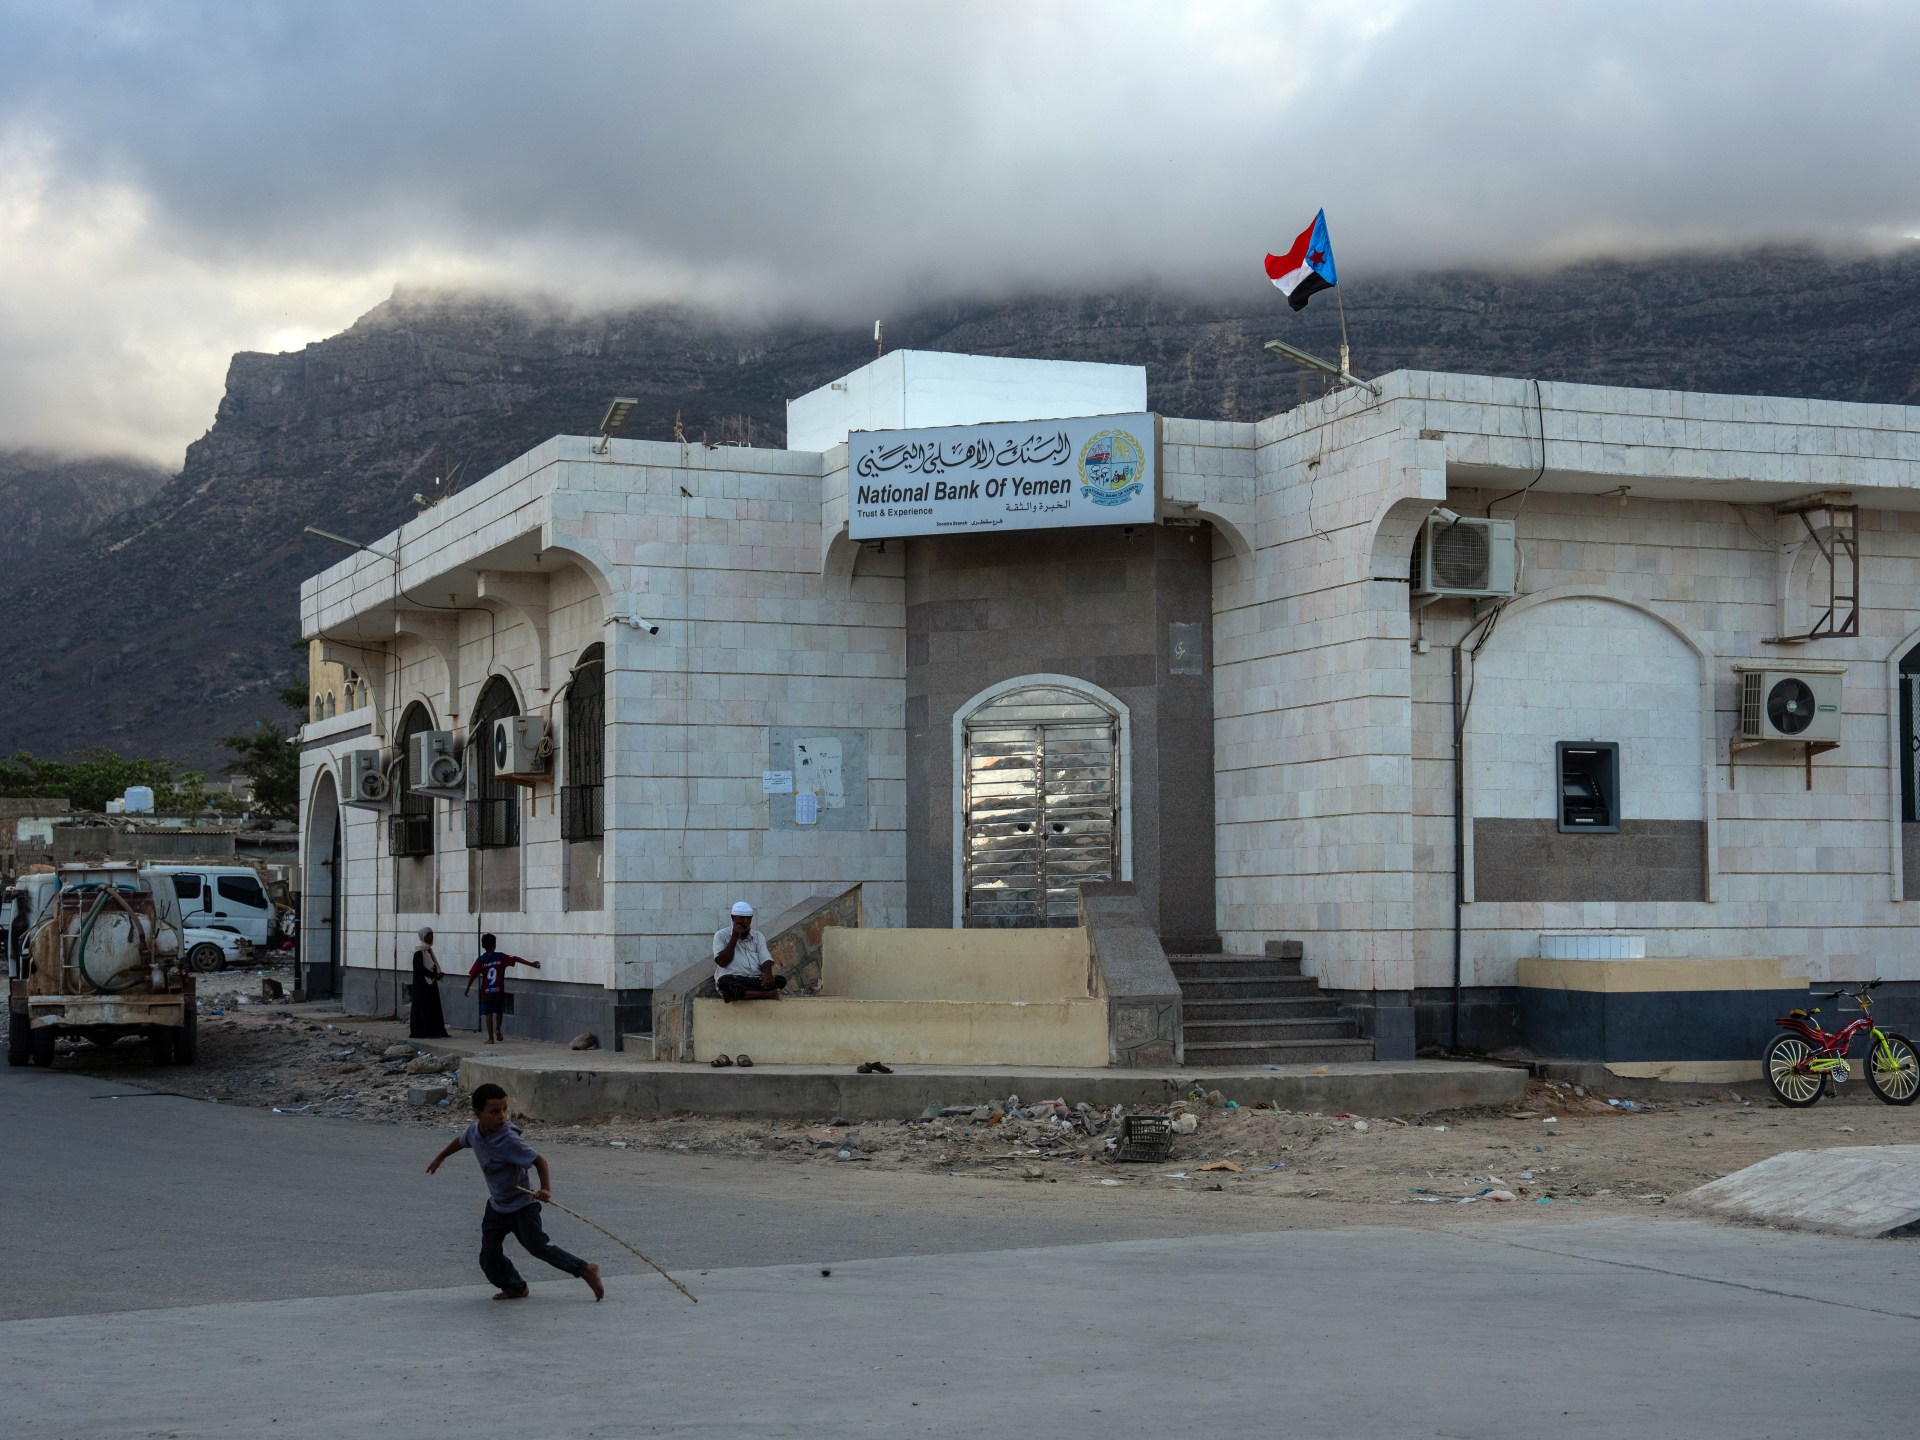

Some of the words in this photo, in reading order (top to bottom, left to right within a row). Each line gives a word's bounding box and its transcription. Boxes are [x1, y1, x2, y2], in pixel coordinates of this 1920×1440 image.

[996, 431, 1071, 466] البنك
[857, 442, 925, 478] اليمني
[857, 482, 930, 505] National
[934, 479, 980, 501] Bank
[985, 478, 1008, 498] Of
[1012, 477, 1071, 496] Yemen
[857, 509, 878, 518] Trust
[879, 508, 886, 517] &
[887, 507, 933, 517] Experience
[1005, 502, 1038, 513] والثقة
[1038, 499, 1071, 512] الخبرة
[486, 967, 497, 985] 9
